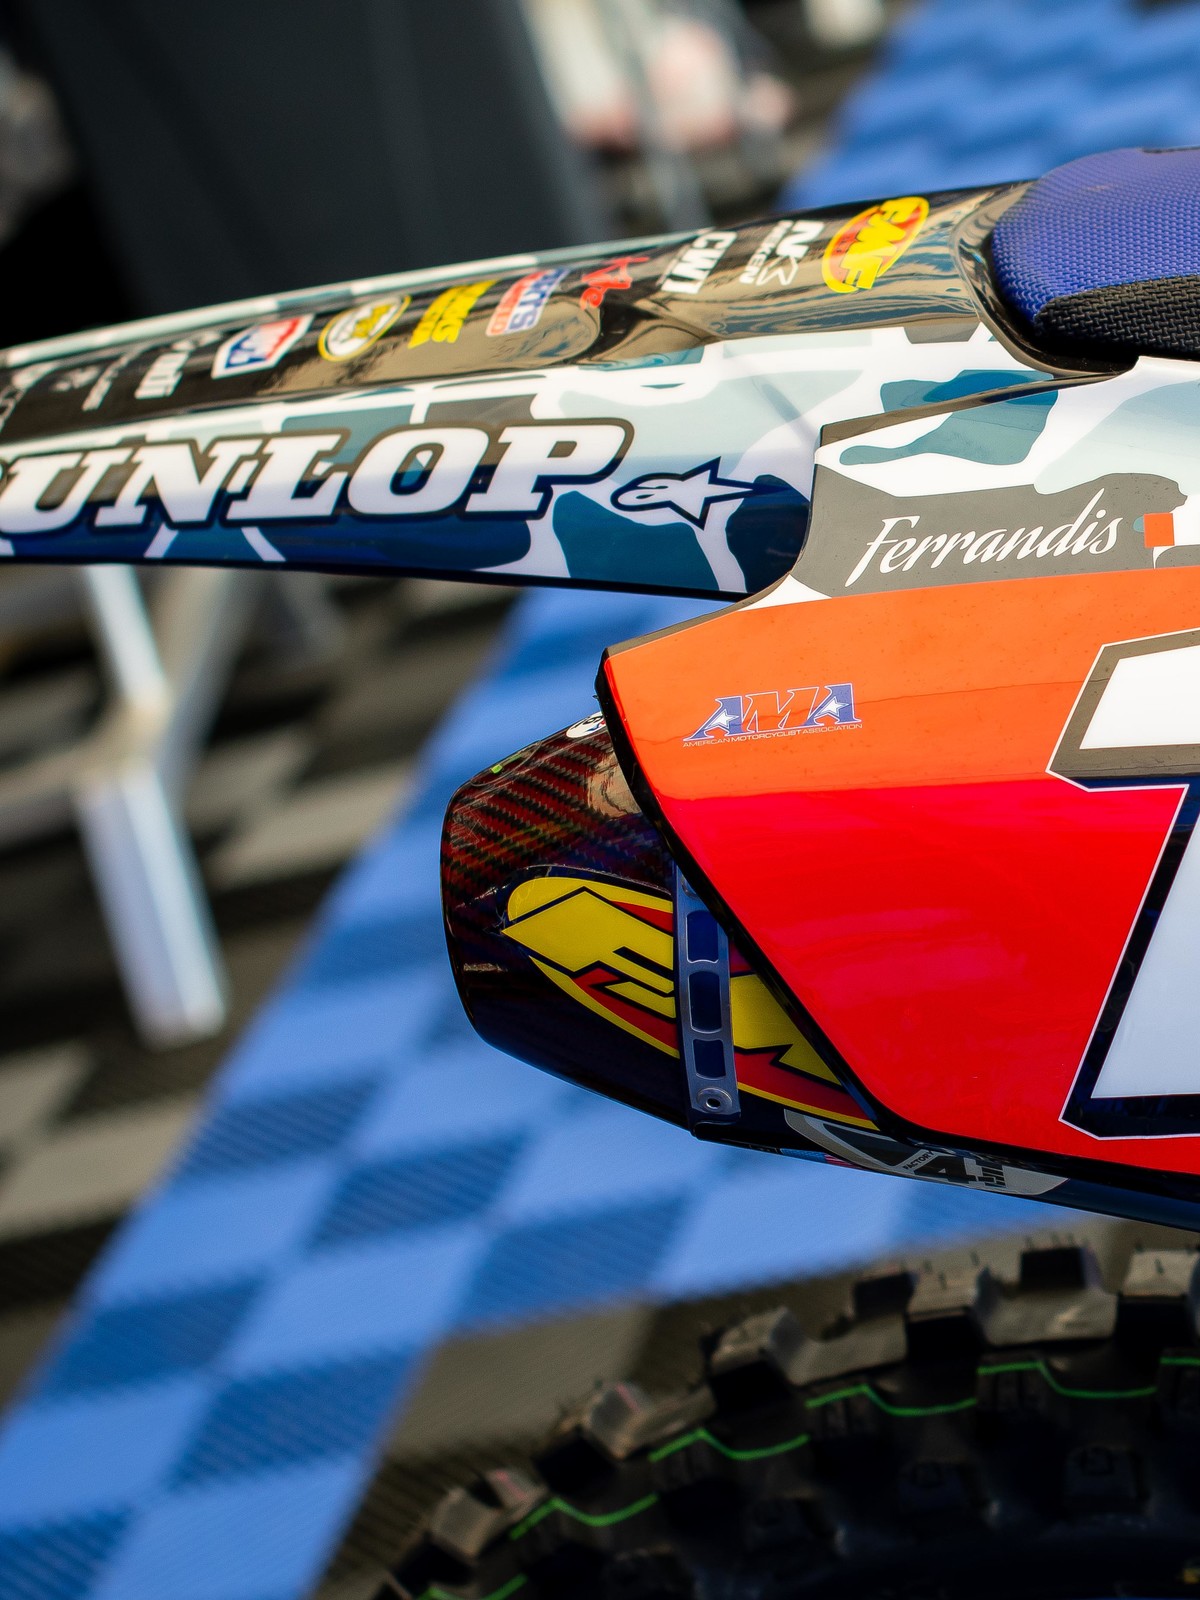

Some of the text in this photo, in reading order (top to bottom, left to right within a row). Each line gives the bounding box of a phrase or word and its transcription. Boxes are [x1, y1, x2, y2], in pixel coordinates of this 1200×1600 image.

[840, 198, 922, 289] FMF
[0, 423, 628, 535] UNLOP
[845, 488, 1124, 588] Ferrandis
[682, 682, 862, 741] AMA
[682, 723, 863, 748] AMERICAN MOTORCYCLIST ASSOCIATION
